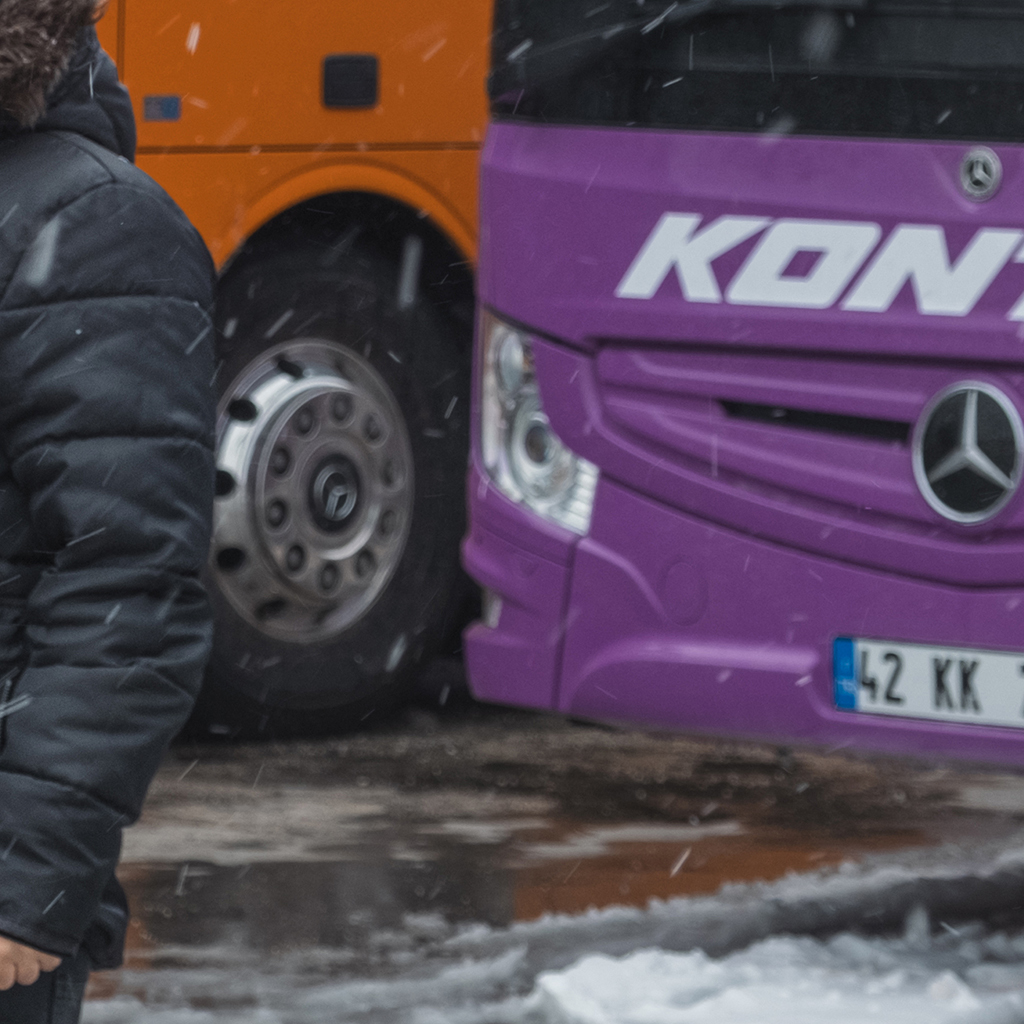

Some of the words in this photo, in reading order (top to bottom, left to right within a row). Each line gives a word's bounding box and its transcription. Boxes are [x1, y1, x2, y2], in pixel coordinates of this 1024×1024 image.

[614, 211, 1024, 322] KON
[860, 650, 904, 703] 42
[932, 657, 981, 712] KK
